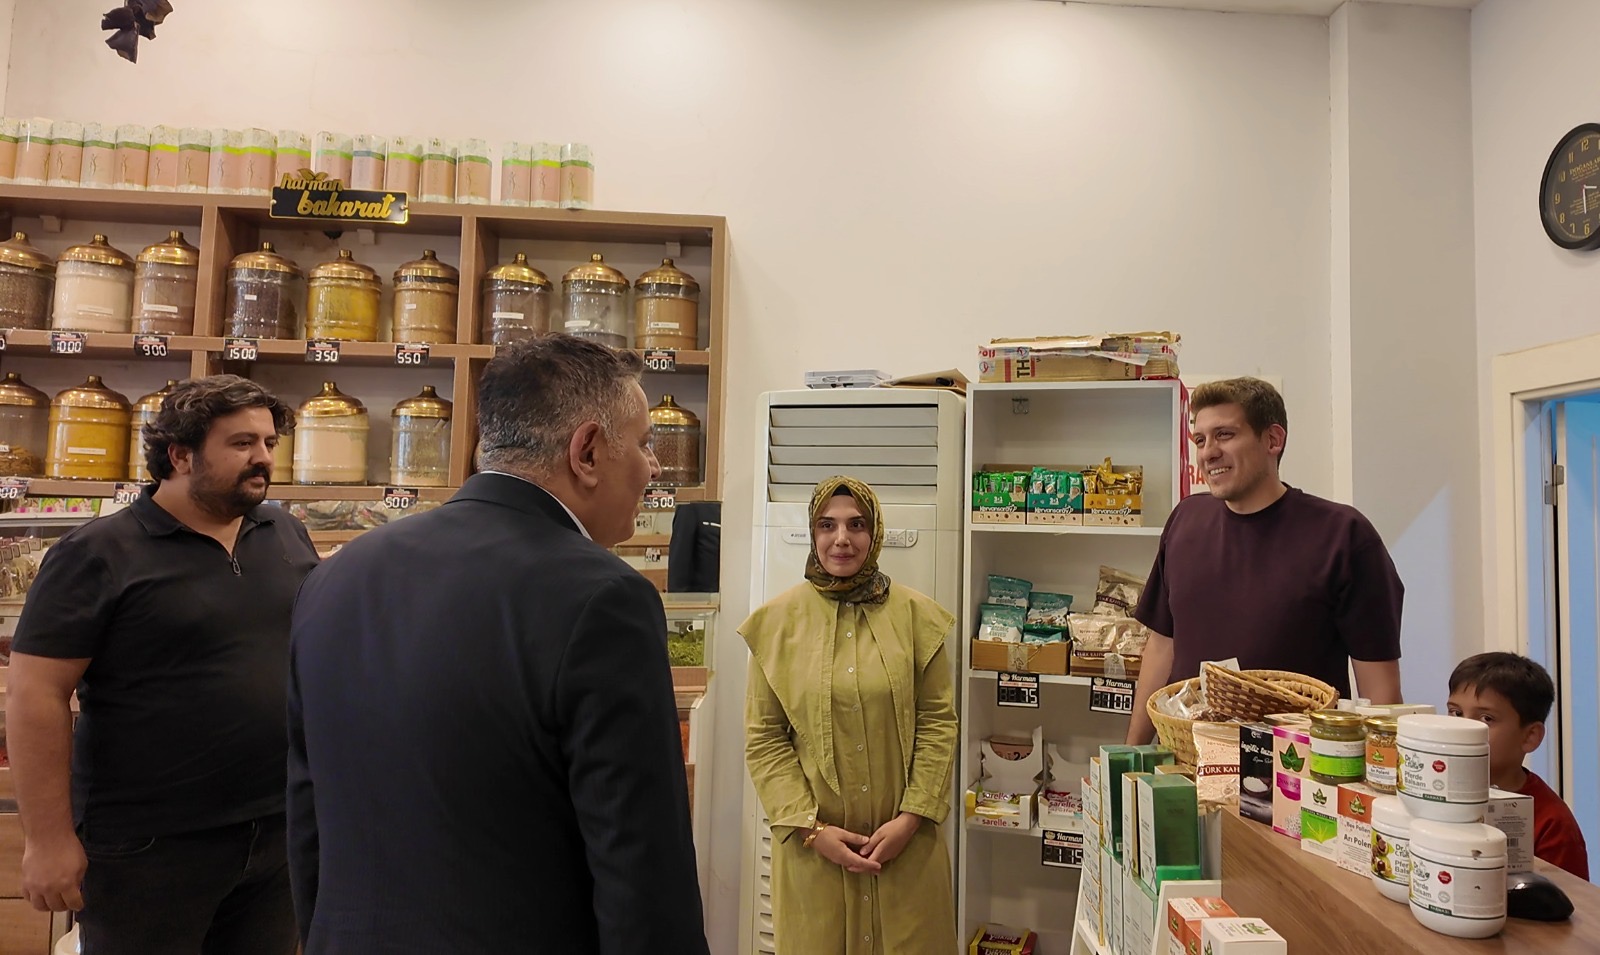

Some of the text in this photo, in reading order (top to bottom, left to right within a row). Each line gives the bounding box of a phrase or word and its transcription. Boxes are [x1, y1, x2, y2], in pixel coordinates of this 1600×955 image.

[1581, 138, 1589, 152] 12
[280, 172, 344, 191] harman
[315, 350, 338, 362] 350
[1011, 673, 1037, 683] Harman
[1105, 678, 1132, 689] Harman
[1020, 688, 1037, 703] 75
[1107, 692, 1132, 711] 100
[982, 791, 1008, 800] sarelle
[1048, 800, 1076, 809] sarelle
[982, 819, 1007, 827] sarelle
[1056, 832, 1083, 843] Harman
